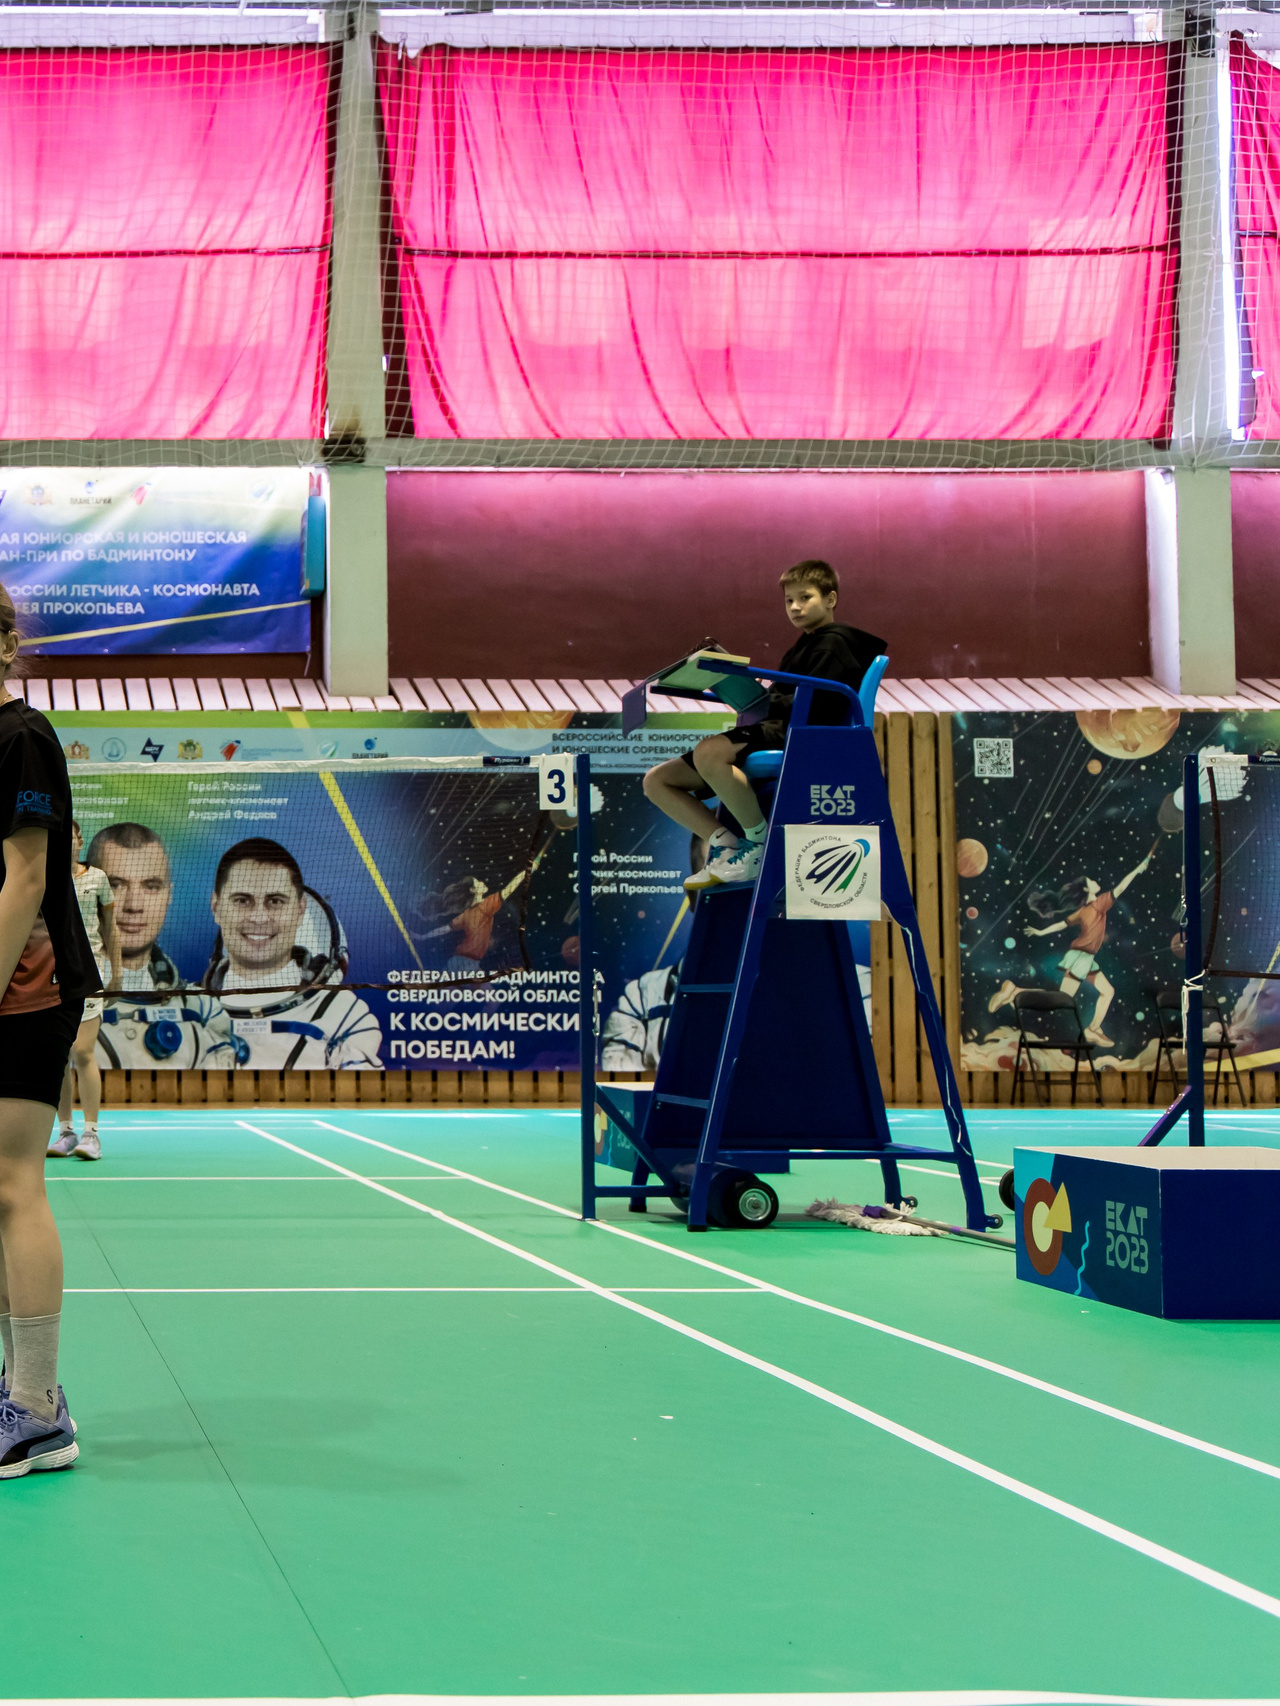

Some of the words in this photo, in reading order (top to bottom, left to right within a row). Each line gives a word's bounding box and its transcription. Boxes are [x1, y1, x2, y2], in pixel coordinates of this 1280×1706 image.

[23, 532, 124, 545] ЮНИОРСКАЯ
[128, 531, 139, 544] И
[142, 531, 248, 544] ЮНОШЕСКАЯ
[61, 549, 84, 561] ПО
[87, 548, 197, 563] БАДМИНТОНУ
[7, 584, 67, 597] ОССИИ
[70, 584, 141, 597] ЛЕТЧИКА
[153, 583, 261, 596] КОСМОНАВТА
[43, 602, 145, 615] ПРОКОПЬЕВА
[552, 745, 559, 753] И
[562, 745, 630, 754] ЮНОШЕСКИЕ
[632, 745, 694, 754] СОРЕВНОВА
[222, 781, 262, 792] России
[547, 769, 566, 804] 3
[17, 790, 51, 806] FORCE
[810, 799, 856, 816] 2023
[801, 836, 841, 853] БАДМИНТОНА
[609, 852, 653, 863] России
[795, 854, 805, 892] ФЕДЕРАЦИЯ
[573, 882, 617, 897] Сргей
[619, 882, 685, 896] Прокопьев
[854, 872, 868, 898] ОБЛАСТИ
[809, 897, 854, 909] СВЕРДЛОВСКОЙ
[387, 985, 519, 1004] СВЕРДЛОВСКОЙ
[522, 989, 602, 1003] ОБЛАСИ
[390, 1012, 406, 1031] К
[410, 1012, 580, 1031] КОСМИЧЕСКИ
[390, 1040, 516, 1062] ПОБЕДАМ!
[1106, 1200, 1148, 1237] EKAT
[1106, 1230, 1149, 1275] 2023
